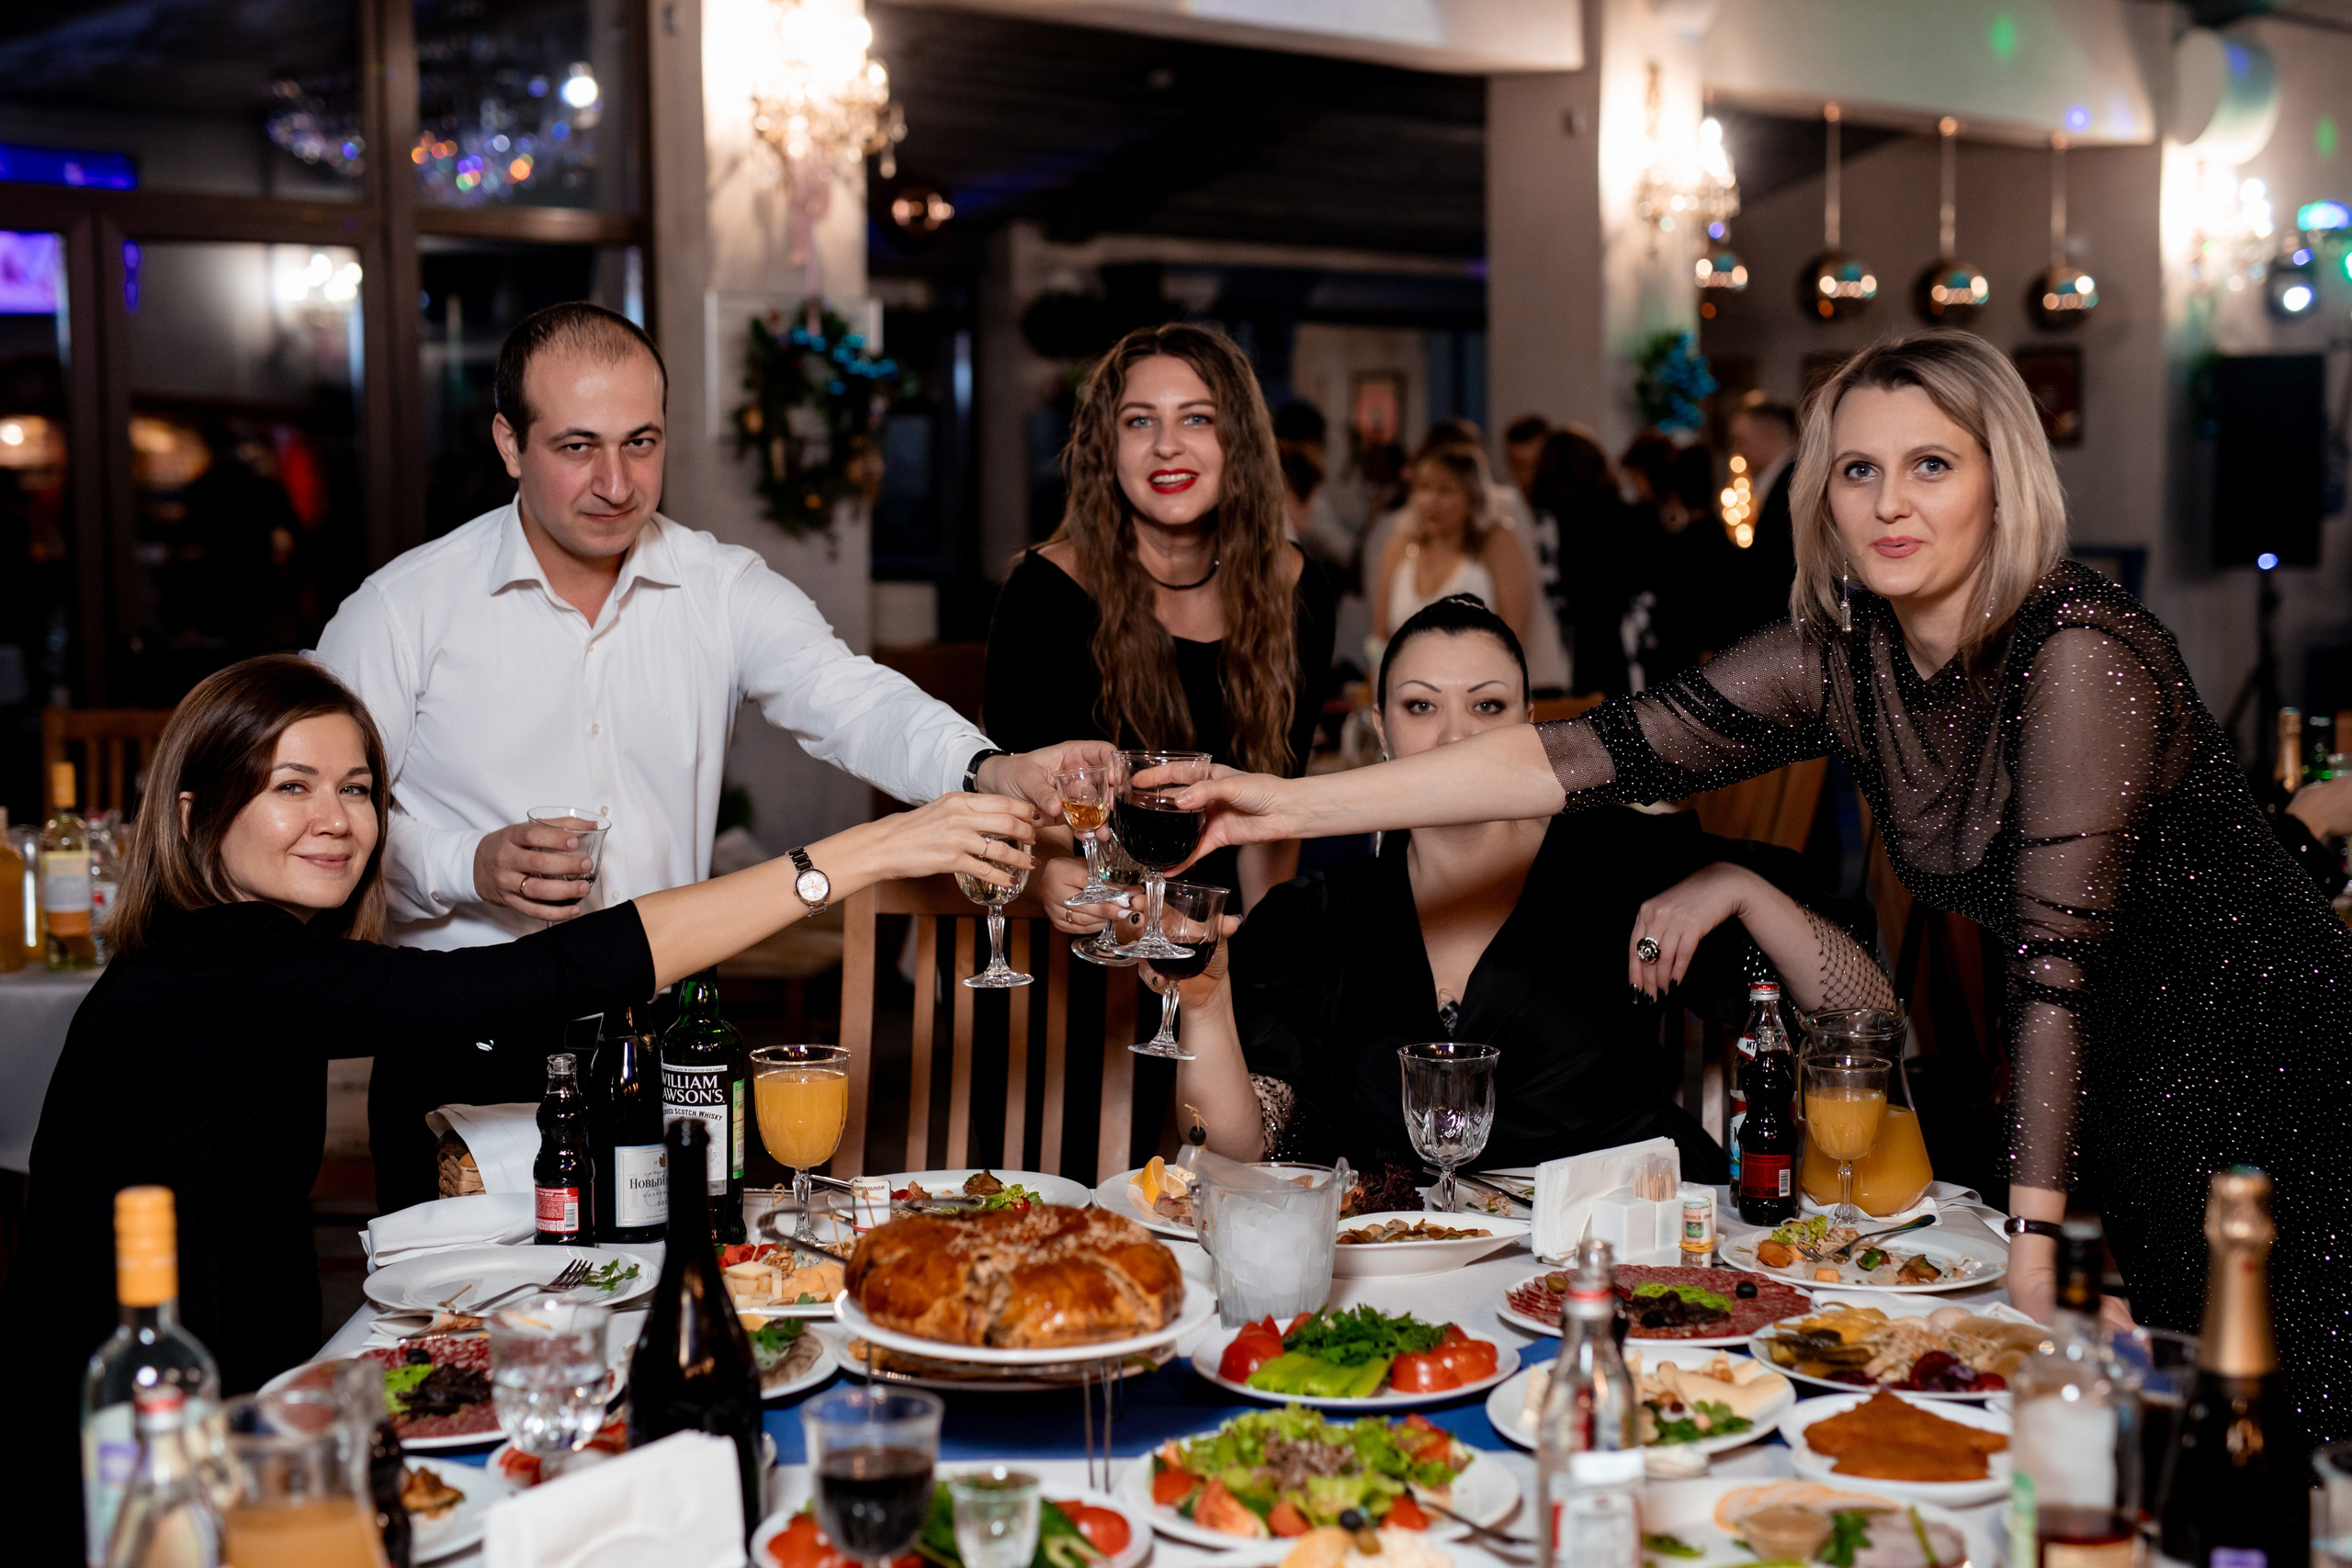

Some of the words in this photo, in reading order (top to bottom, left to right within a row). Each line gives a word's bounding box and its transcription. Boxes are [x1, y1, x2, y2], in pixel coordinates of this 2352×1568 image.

[662, 1088, 724, 1103] AWSON'S
[674, 1108, 696, 1116] SCOTCH
[699, 1111, 722, 1121] WHISKY
